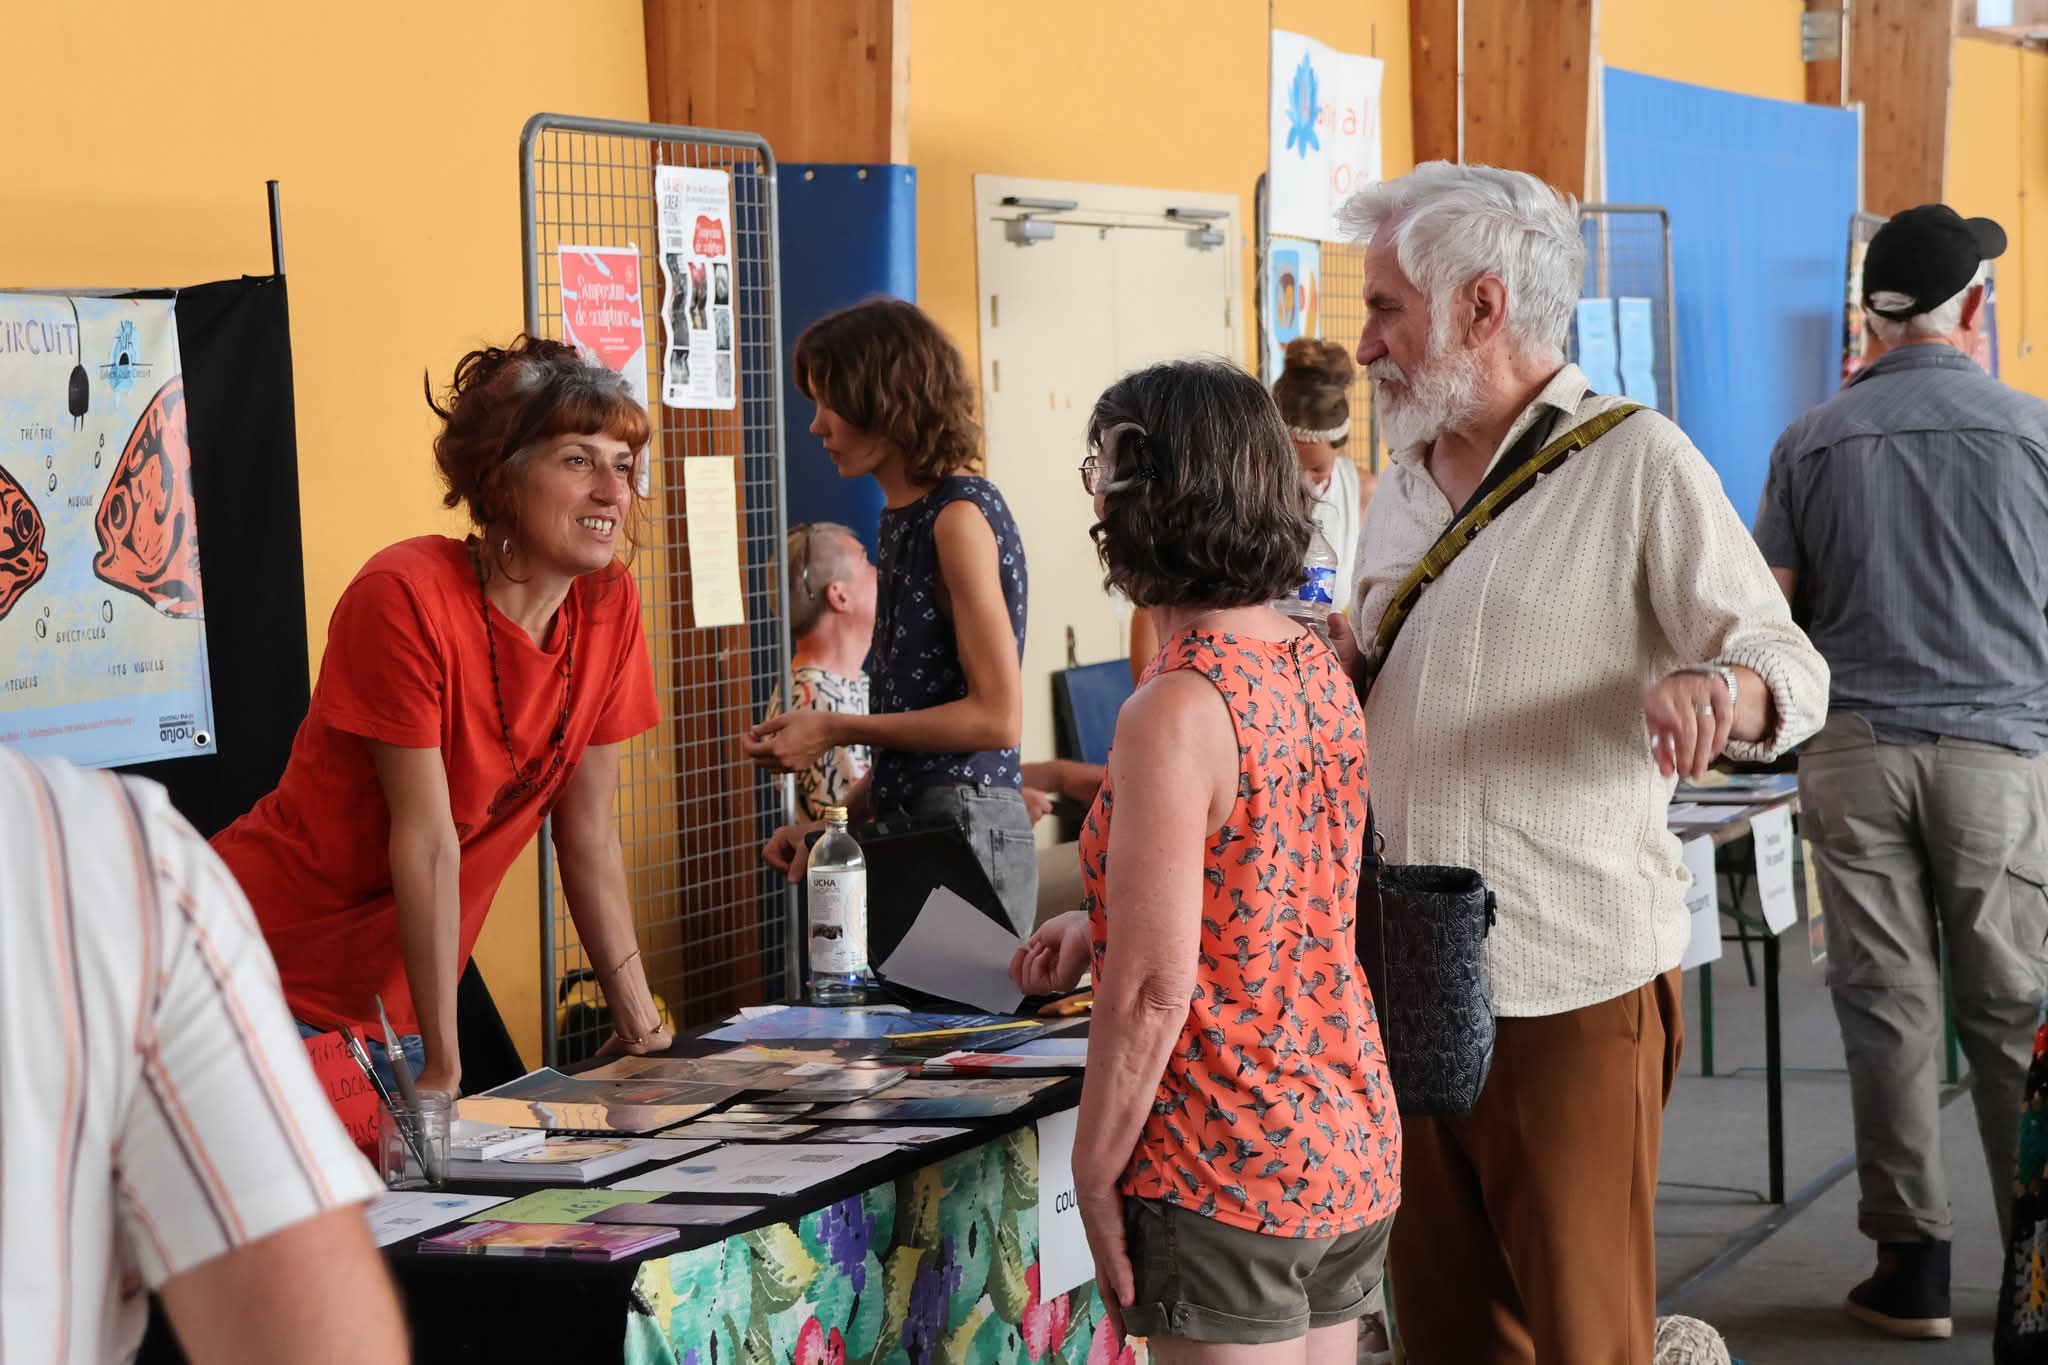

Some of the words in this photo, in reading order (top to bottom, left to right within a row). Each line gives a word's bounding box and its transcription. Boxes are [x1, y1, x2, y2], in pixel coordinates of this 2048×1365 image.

[56, 626, 107, 643] SPECTACLES
[133, 659, 165, 673] VISUELS
[1056, 1188, 1076, 1214] COU
